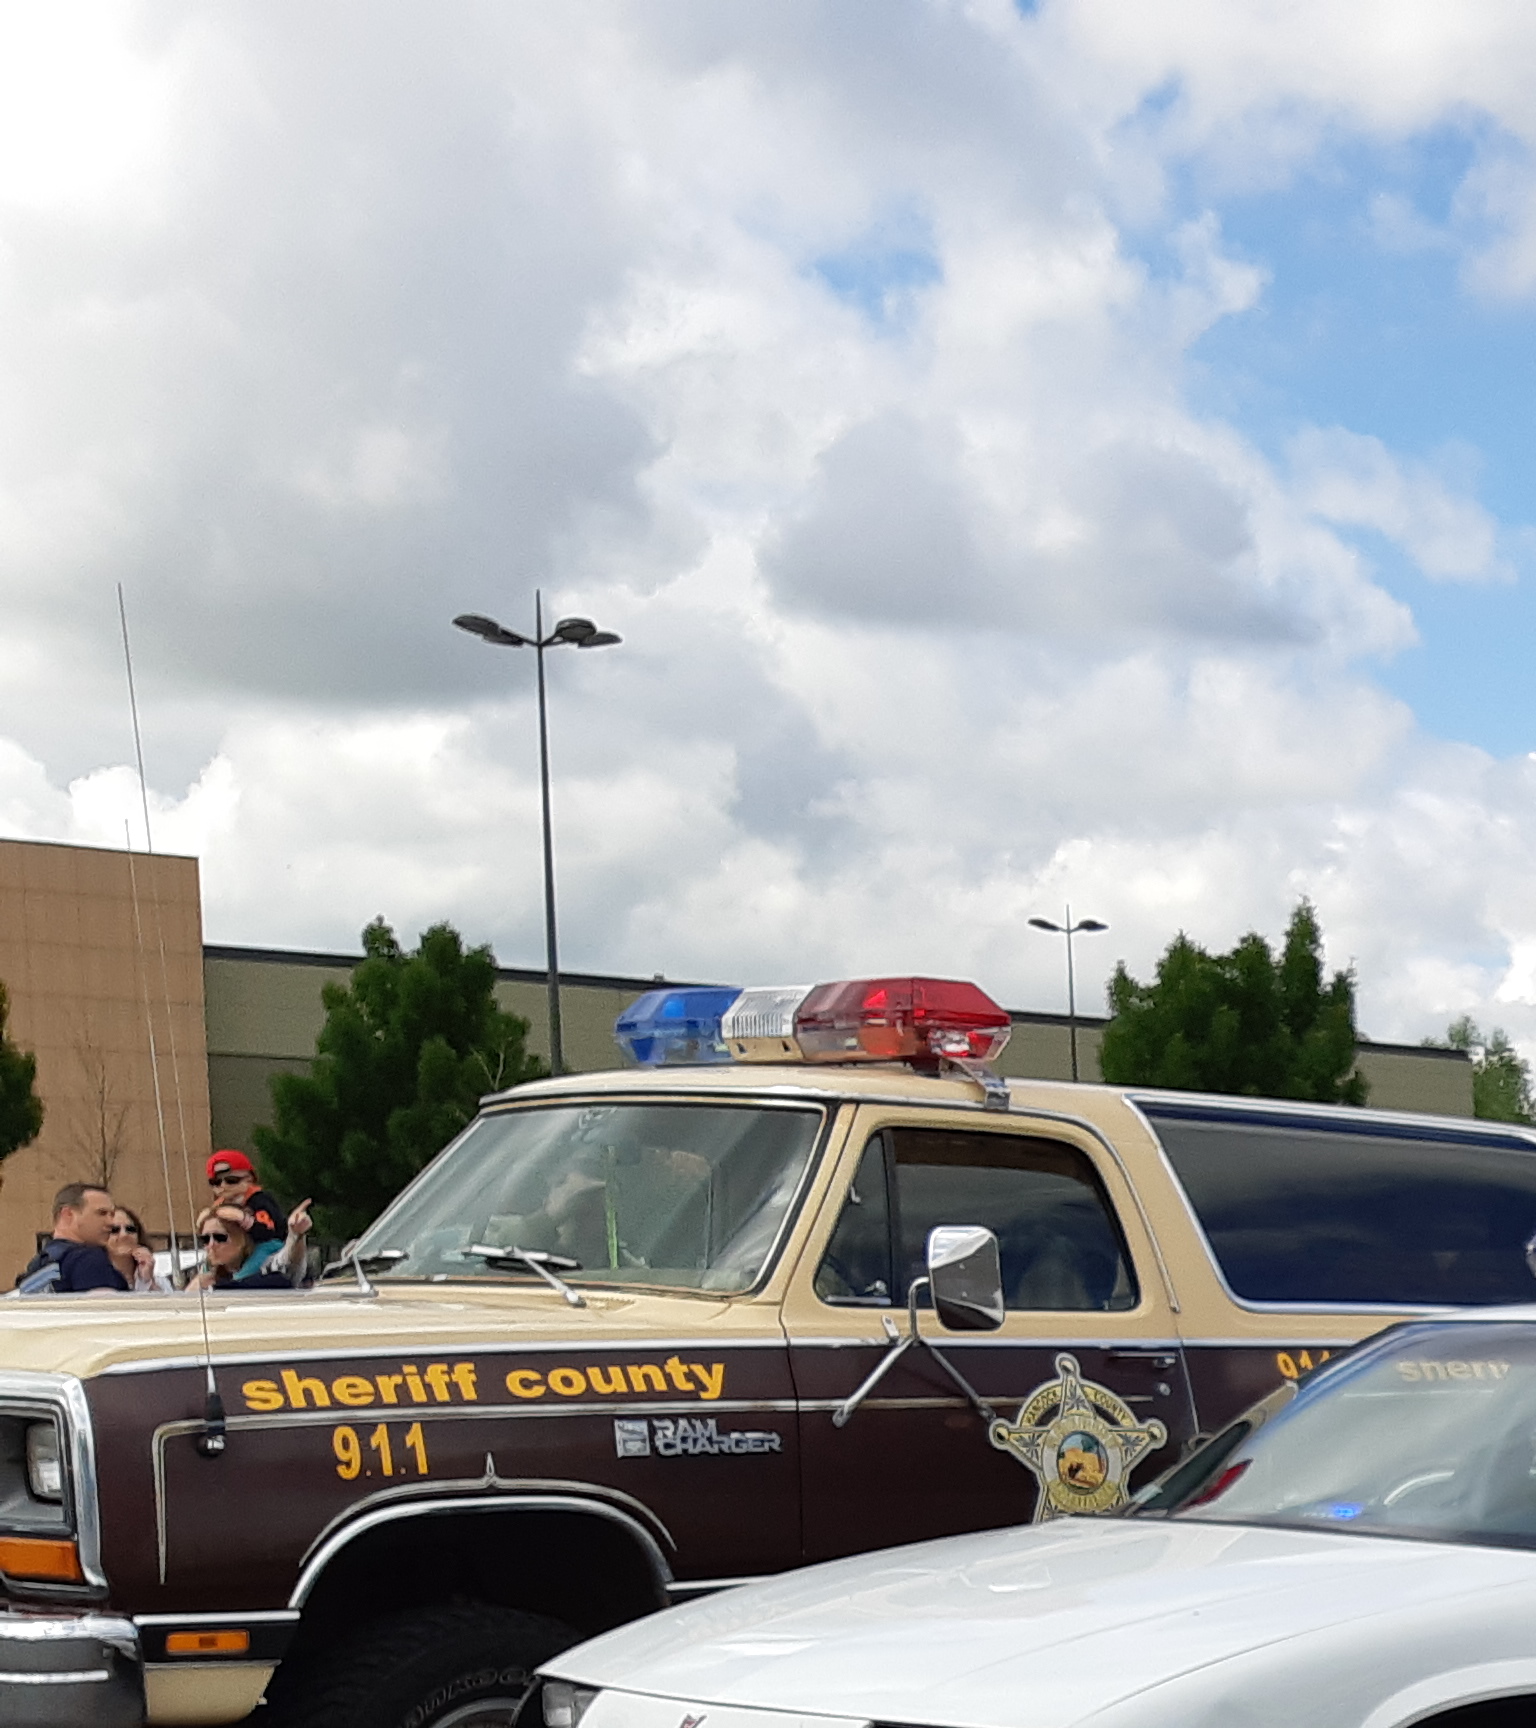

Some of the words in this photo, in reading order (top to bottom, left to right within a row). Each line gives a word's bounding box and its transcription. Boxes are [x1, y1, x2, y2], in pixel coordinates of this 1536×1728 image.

[242, 1362, 478, 1411] sheriff
[505, 1356, 726, 1400] county
[652, 1418, 717, 1439] RAM
[654, 1431, 783, 1456] CHARGER
